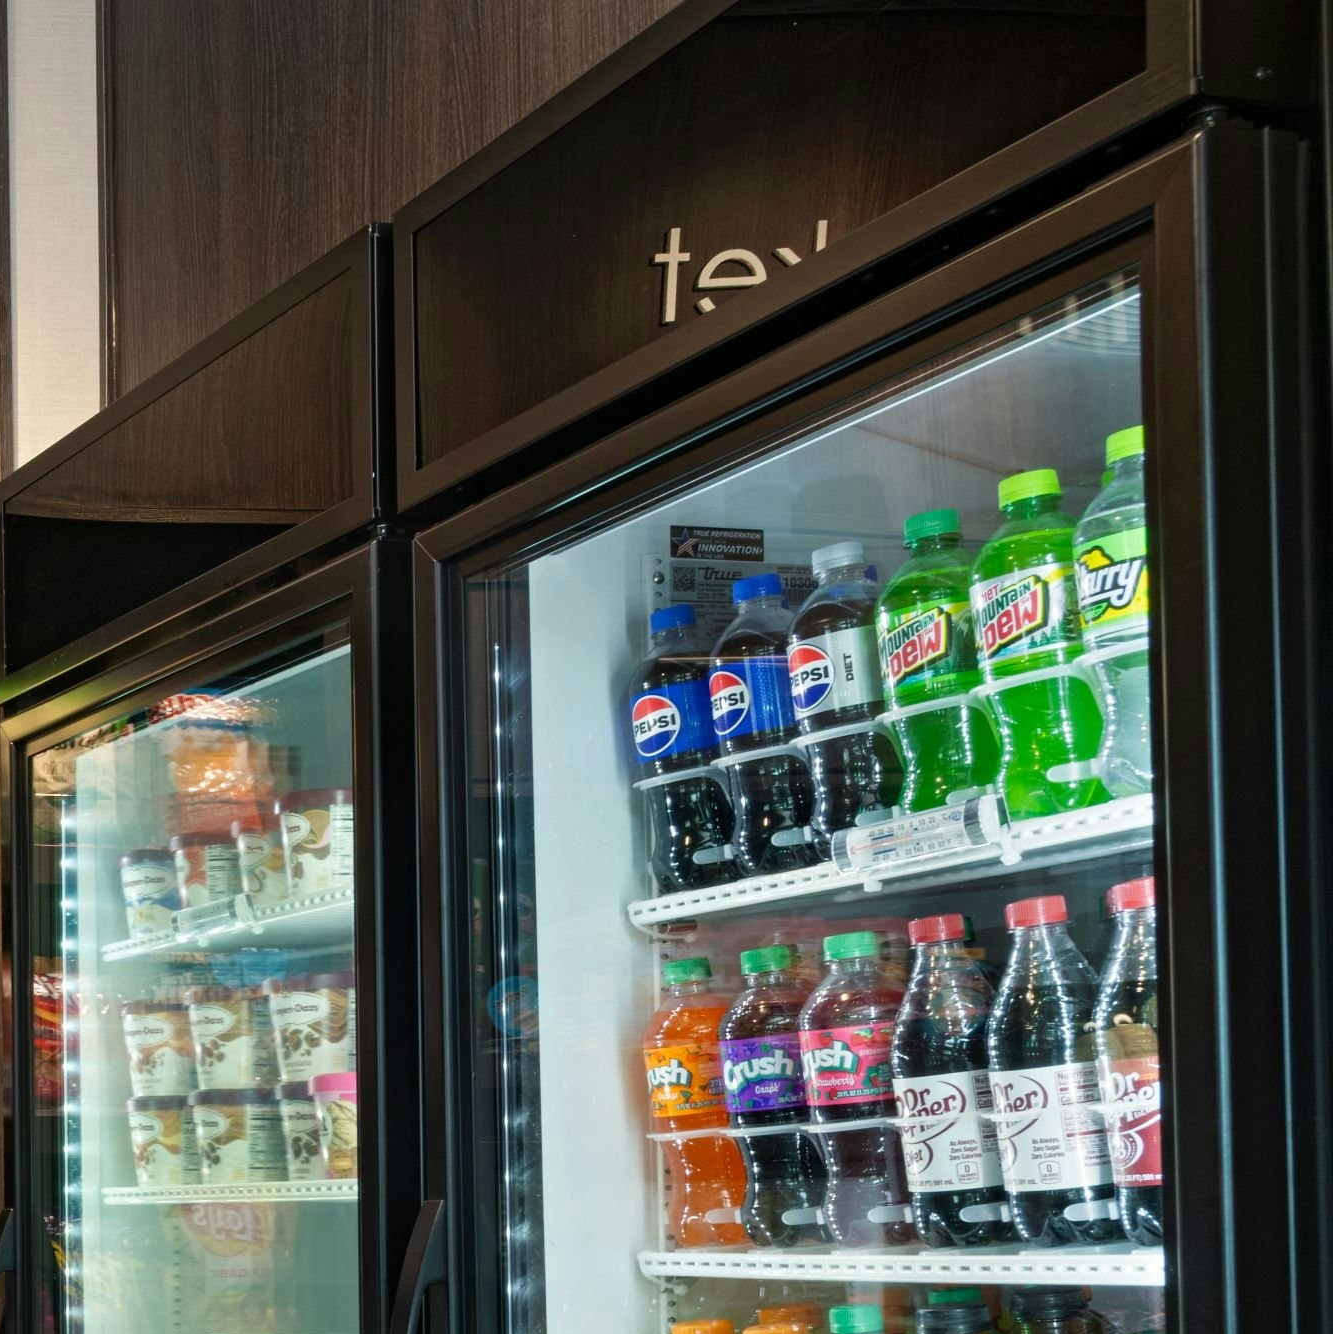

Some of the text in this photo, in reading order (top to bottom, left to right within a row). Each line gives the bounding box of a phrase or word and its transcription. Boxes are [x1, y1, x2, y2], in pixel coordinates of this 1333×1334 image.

[789, 664, 829, 689] PEPSI
[845, 653, 854, 682] DIET
[634, 714, 678, 735] PEPSI
[724, 1050, 796, 1090] Crush
